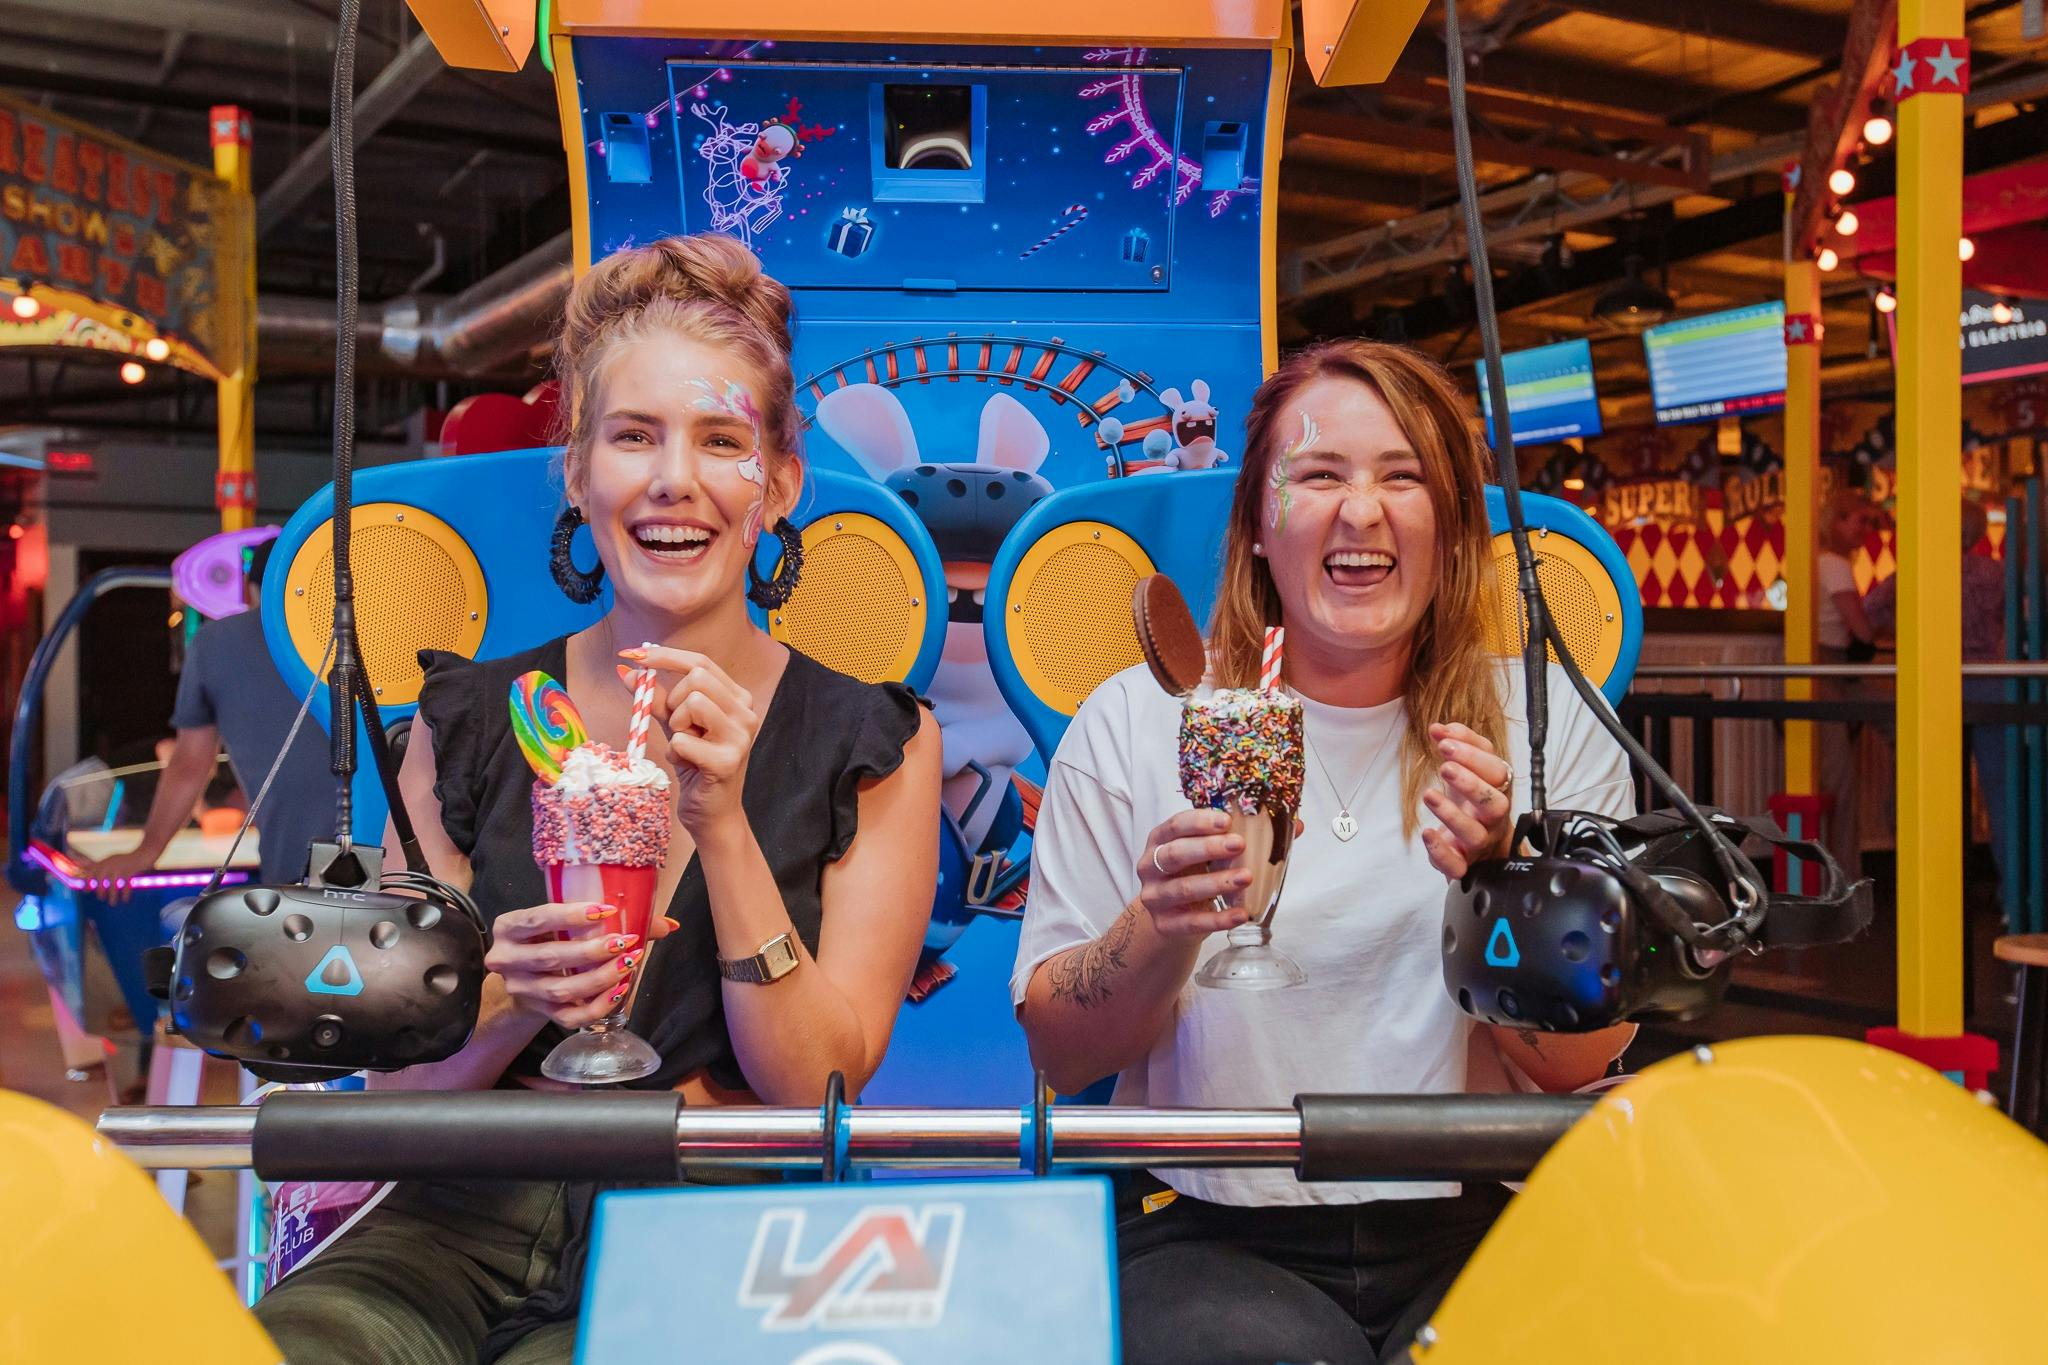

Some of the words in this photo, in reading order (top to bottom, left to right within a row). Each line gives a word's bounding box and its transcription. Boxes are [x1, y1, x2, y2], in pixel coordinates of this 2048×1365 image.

[3, 184, 109, 246] SHOW
[1604, 480, 1692, 526] SUPER
[1339, 822, 1351, 833] M
[279, 1227, 314, 1262] CLUB
